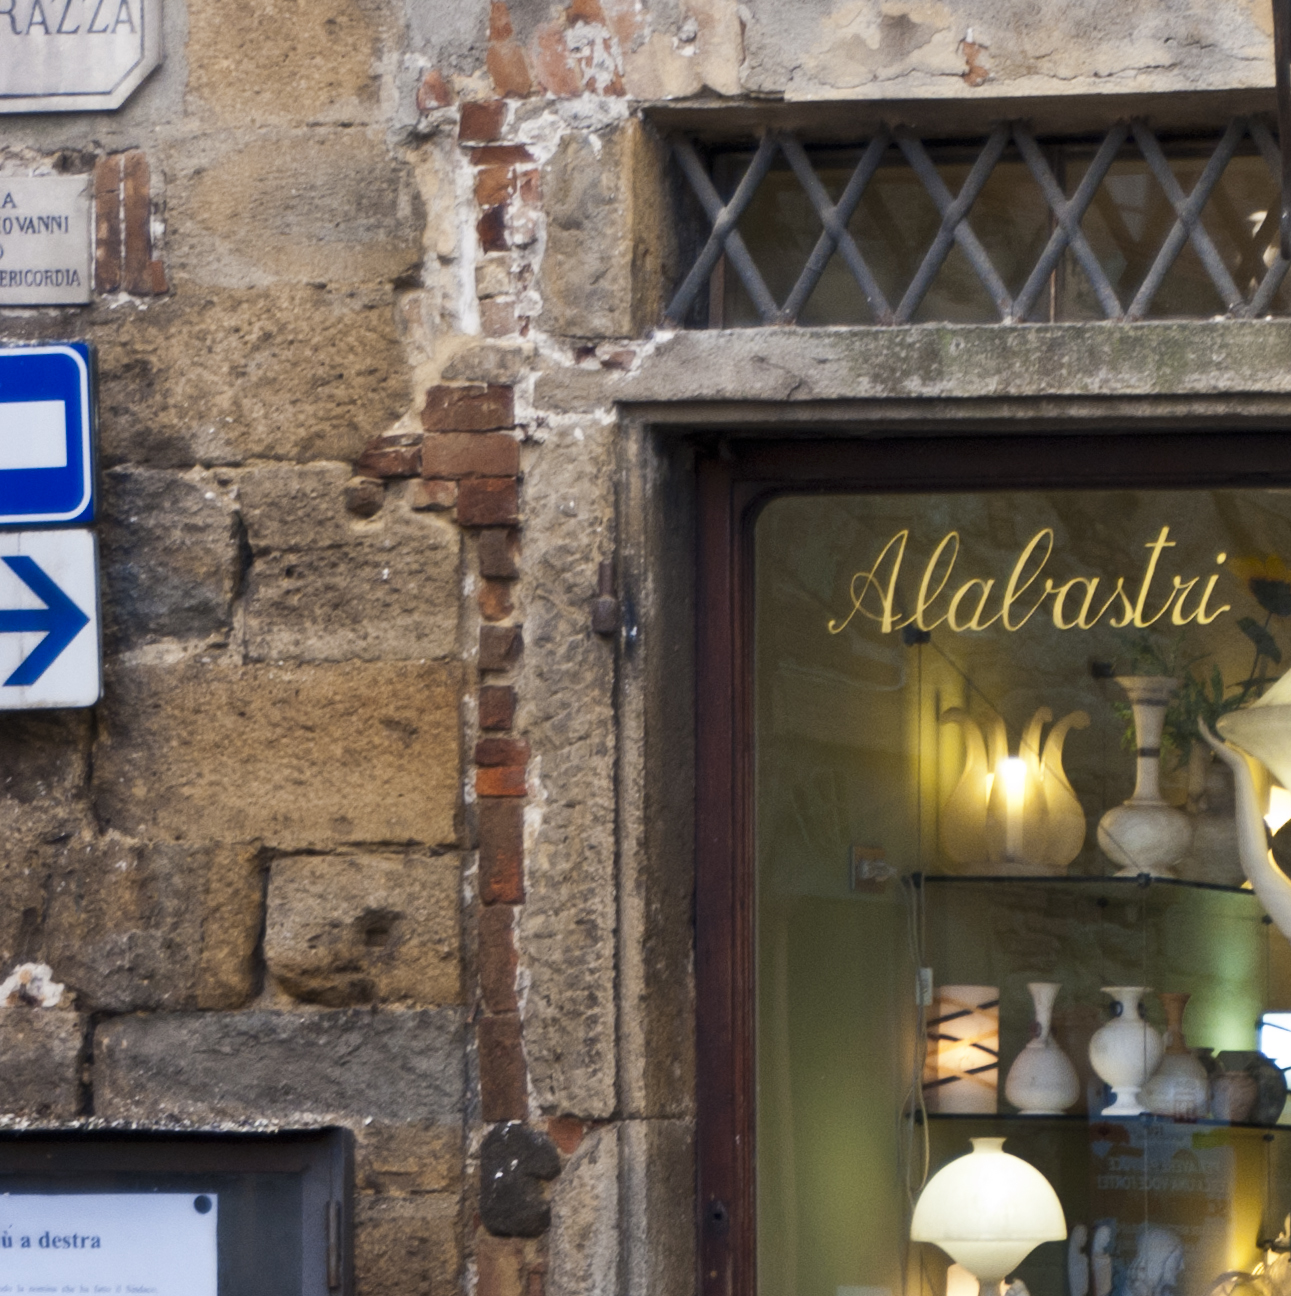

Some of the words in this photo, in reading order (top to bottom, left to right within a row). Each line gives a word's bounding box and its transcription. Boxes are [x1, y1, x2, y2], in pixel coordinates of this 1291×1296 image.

[827, 525, 1232, 635] Alabastri
[20, 1235, 31, 1249] a
[38, 1230, 101, 1249] destra
